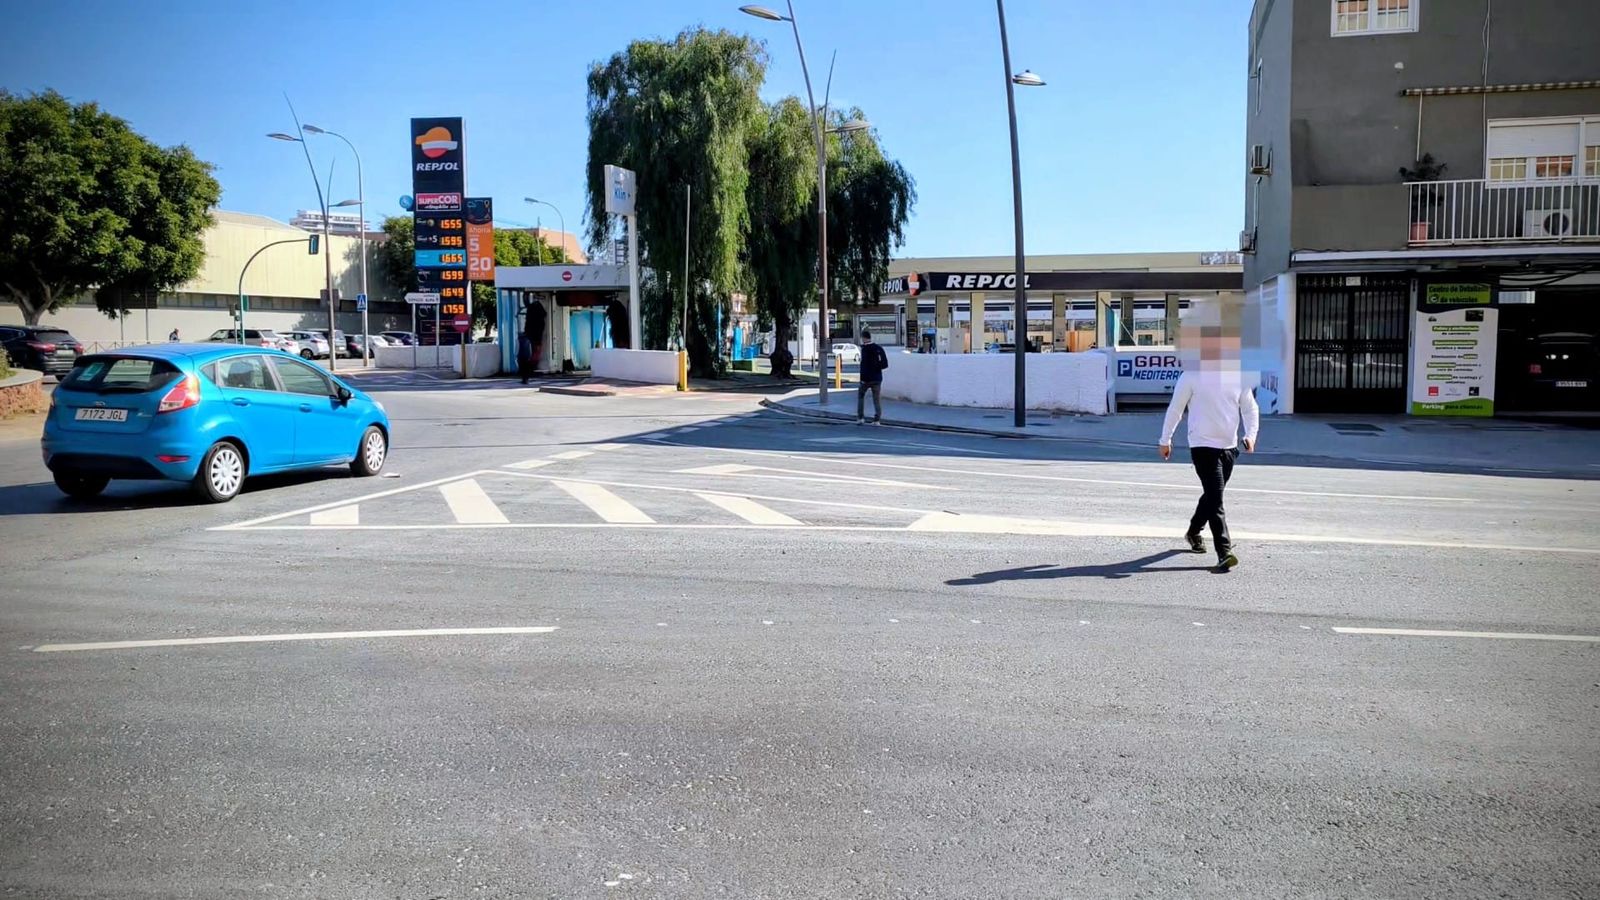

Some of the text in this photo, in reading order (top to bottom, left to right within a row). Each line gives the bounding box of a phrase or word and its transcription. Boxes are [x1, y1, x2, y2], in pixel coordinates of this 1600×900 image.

[416, 162, 459, 171] REPSOL
[470, 257, 492, 271] 20
[946, 275, 1031, 288] REPSOL
[1135, 356, 1182, 367] GAR
[1422, 403, 1445, 411] Parking
[82, 409, 124, 420] 7172 JGL
